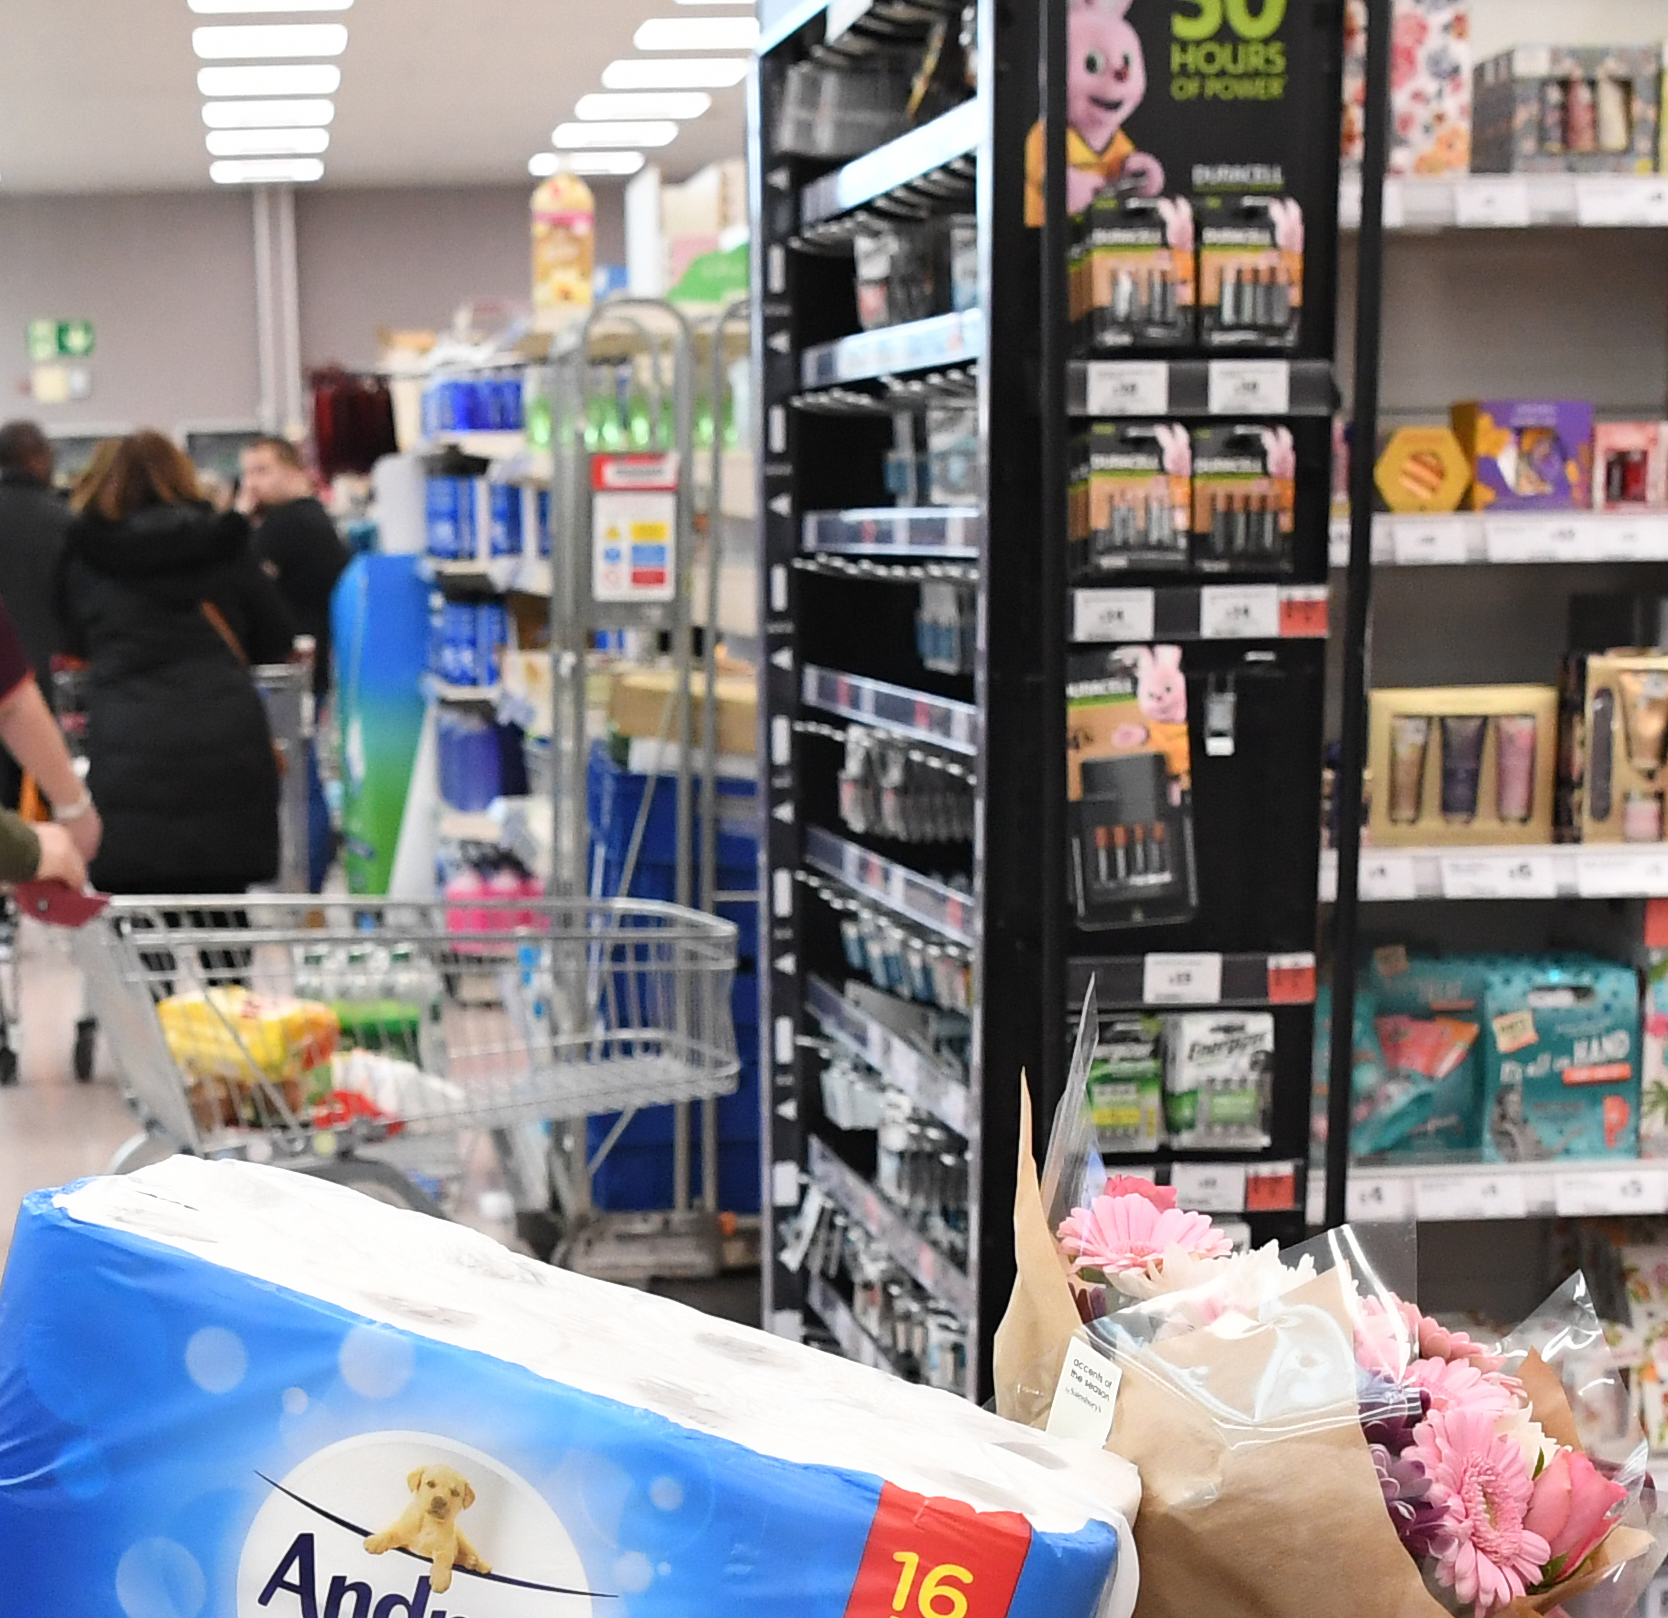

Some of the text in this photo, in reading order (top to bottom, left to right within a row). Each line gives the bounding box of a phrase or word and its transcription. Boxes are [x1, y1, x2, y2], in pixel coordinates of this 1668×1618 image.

[1170, 40, 1287, 75] HOURS
[1170, 75, 1288, 100] OF POWER
[1070, 1368, 1111, 1402] the season
[1073, 1358, 1113, 1389] accents of
